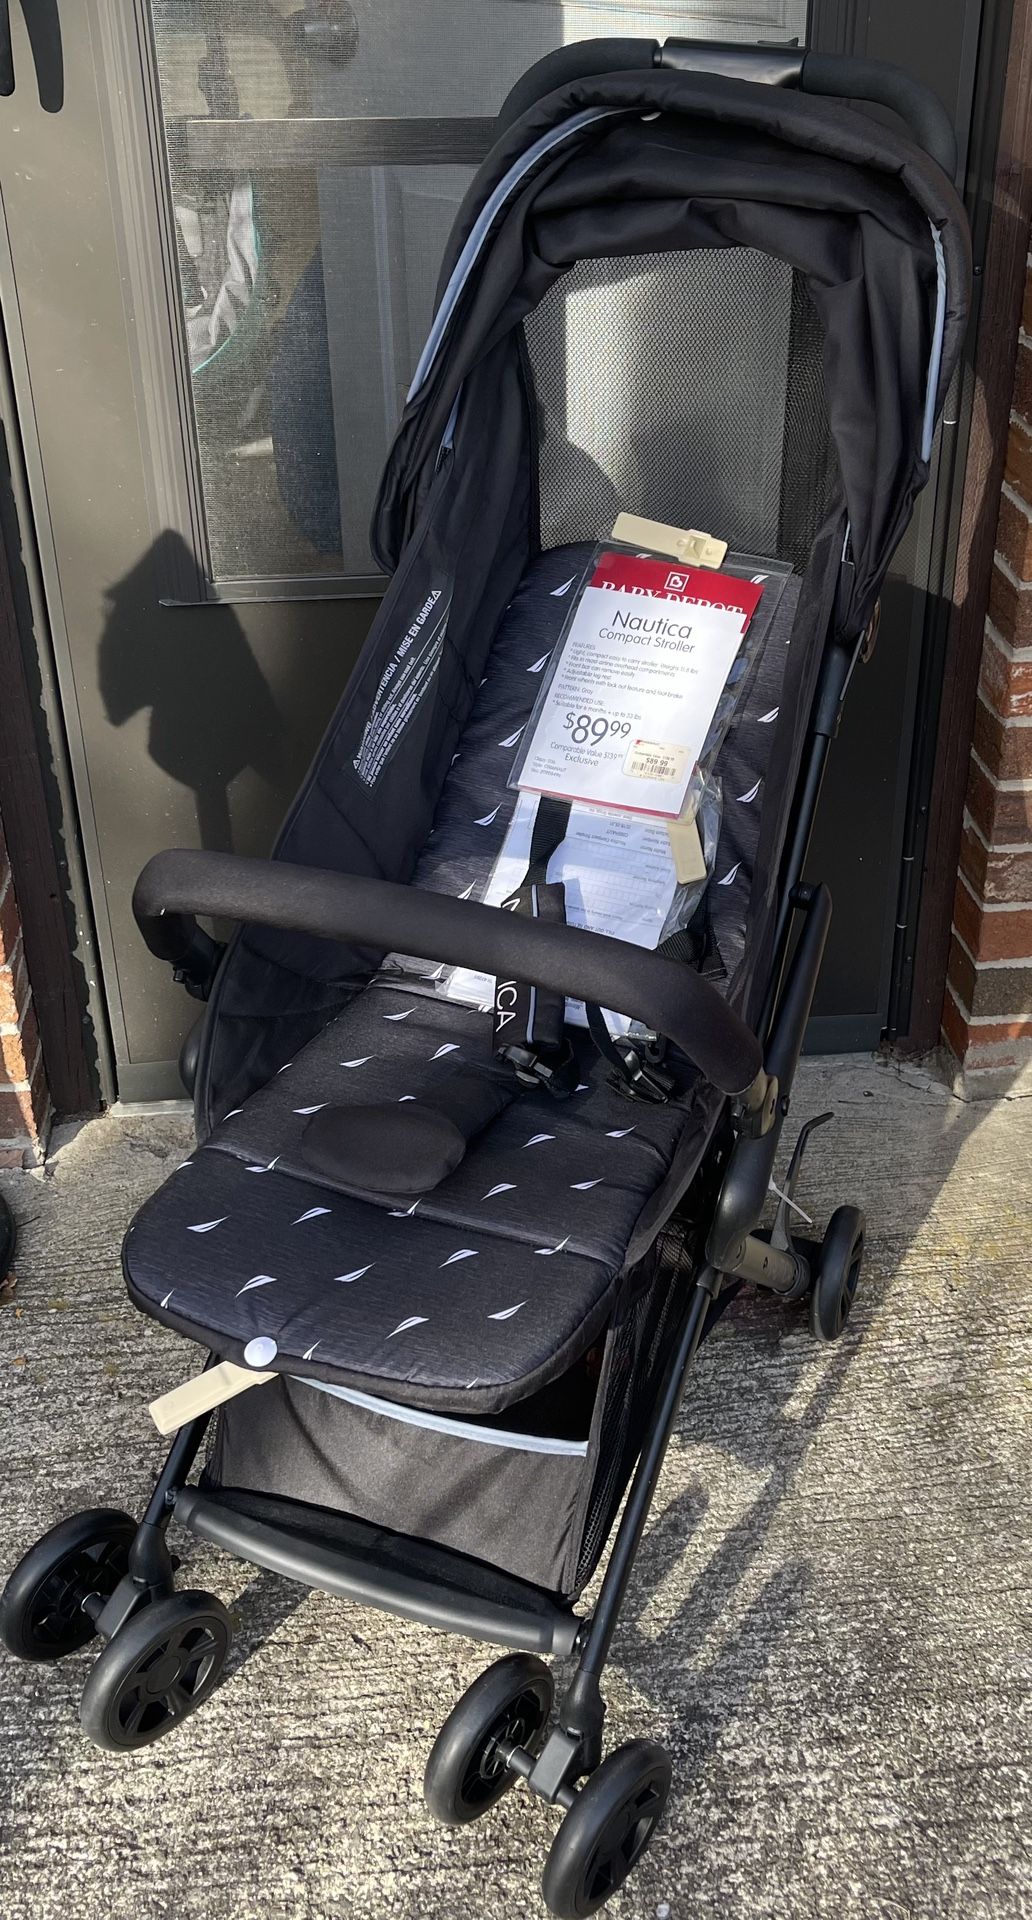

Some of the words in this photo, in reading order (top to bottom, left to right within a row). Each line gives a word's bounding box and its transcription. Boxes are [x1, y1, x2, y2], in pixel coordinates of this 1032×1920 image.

[396, 635, 414, 657] MISE
[408, 623, 421, 637] EN
[416, 596, 436, 625] GARDE
[612, 610, 692, 638] Nautica
[598, 627, 651, 645] Compact
[653, 636, 695, 653] Stroller
[550, 741, 586, 754] Comparable
[586, 748, 603, 758] Value
[564, 752, 599, 766] Exclusive
